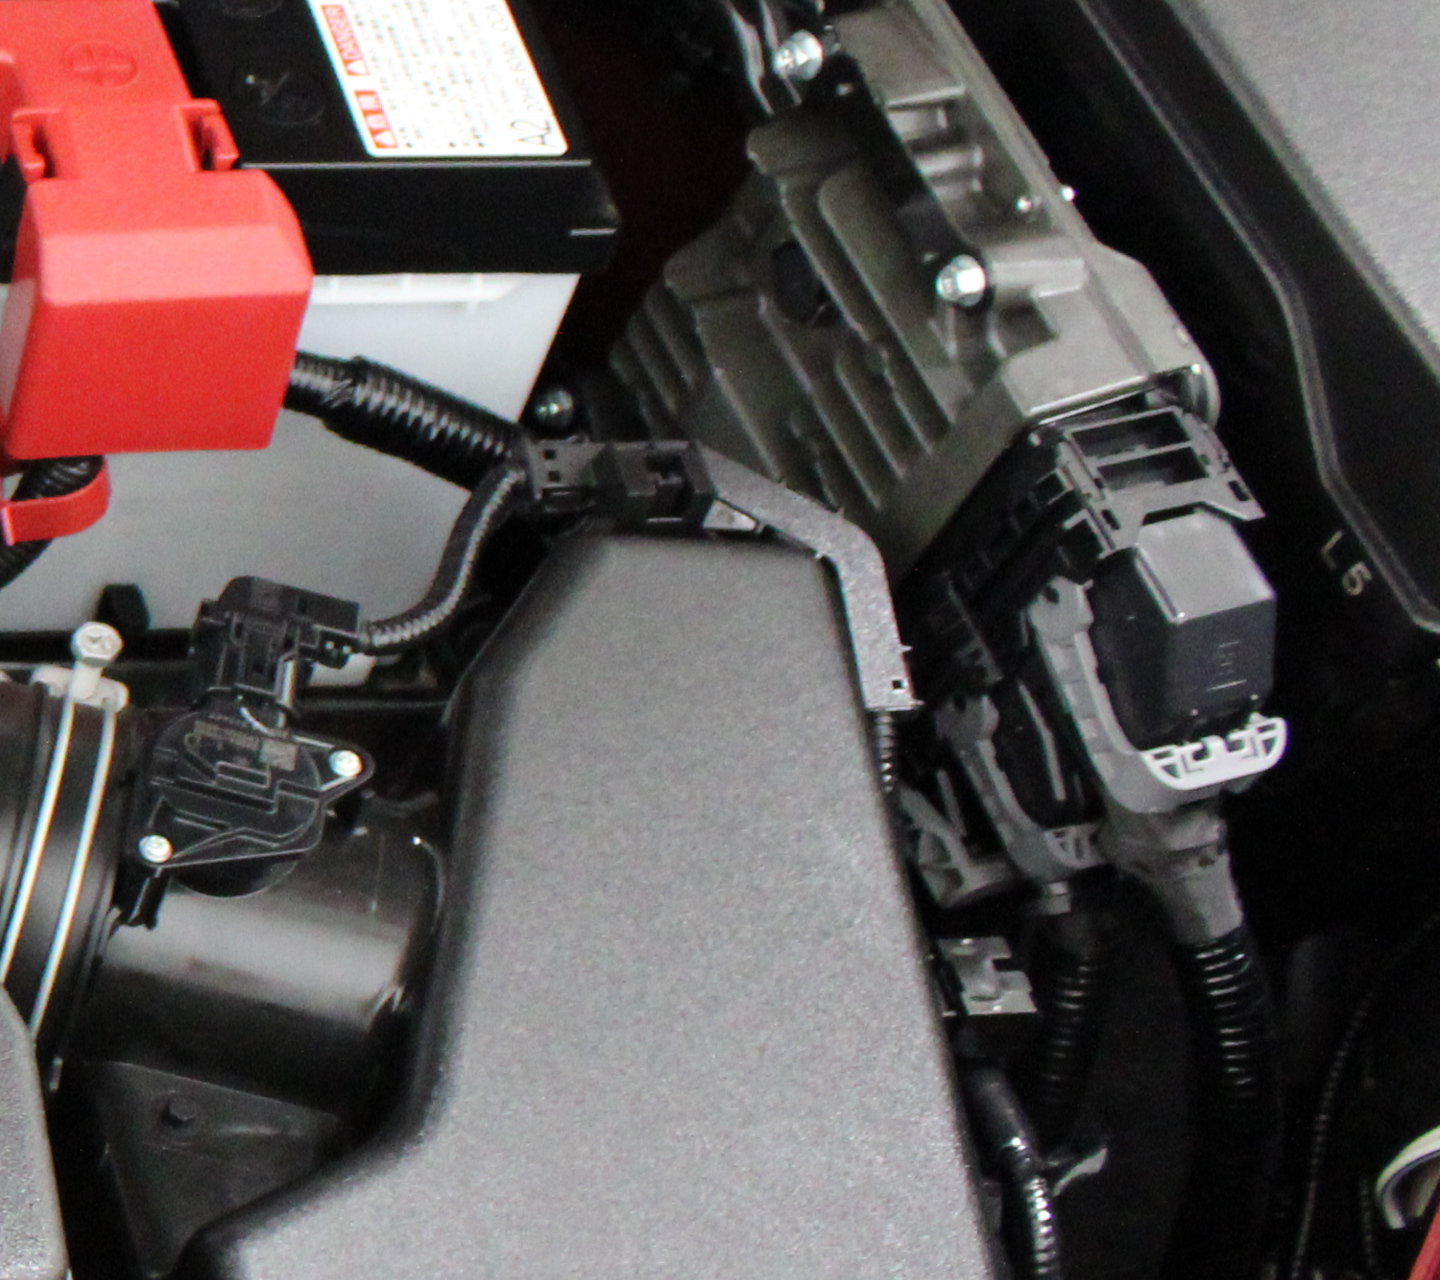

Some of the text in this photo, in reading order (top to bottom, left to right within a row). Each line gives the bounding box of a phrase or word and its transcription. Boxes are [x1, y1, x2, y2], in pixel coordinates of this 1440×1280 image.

[324, 7, 359, 60] DANGER
[509, 118, 553, 148] A2
[1320, 530, 1373, 597] L5
